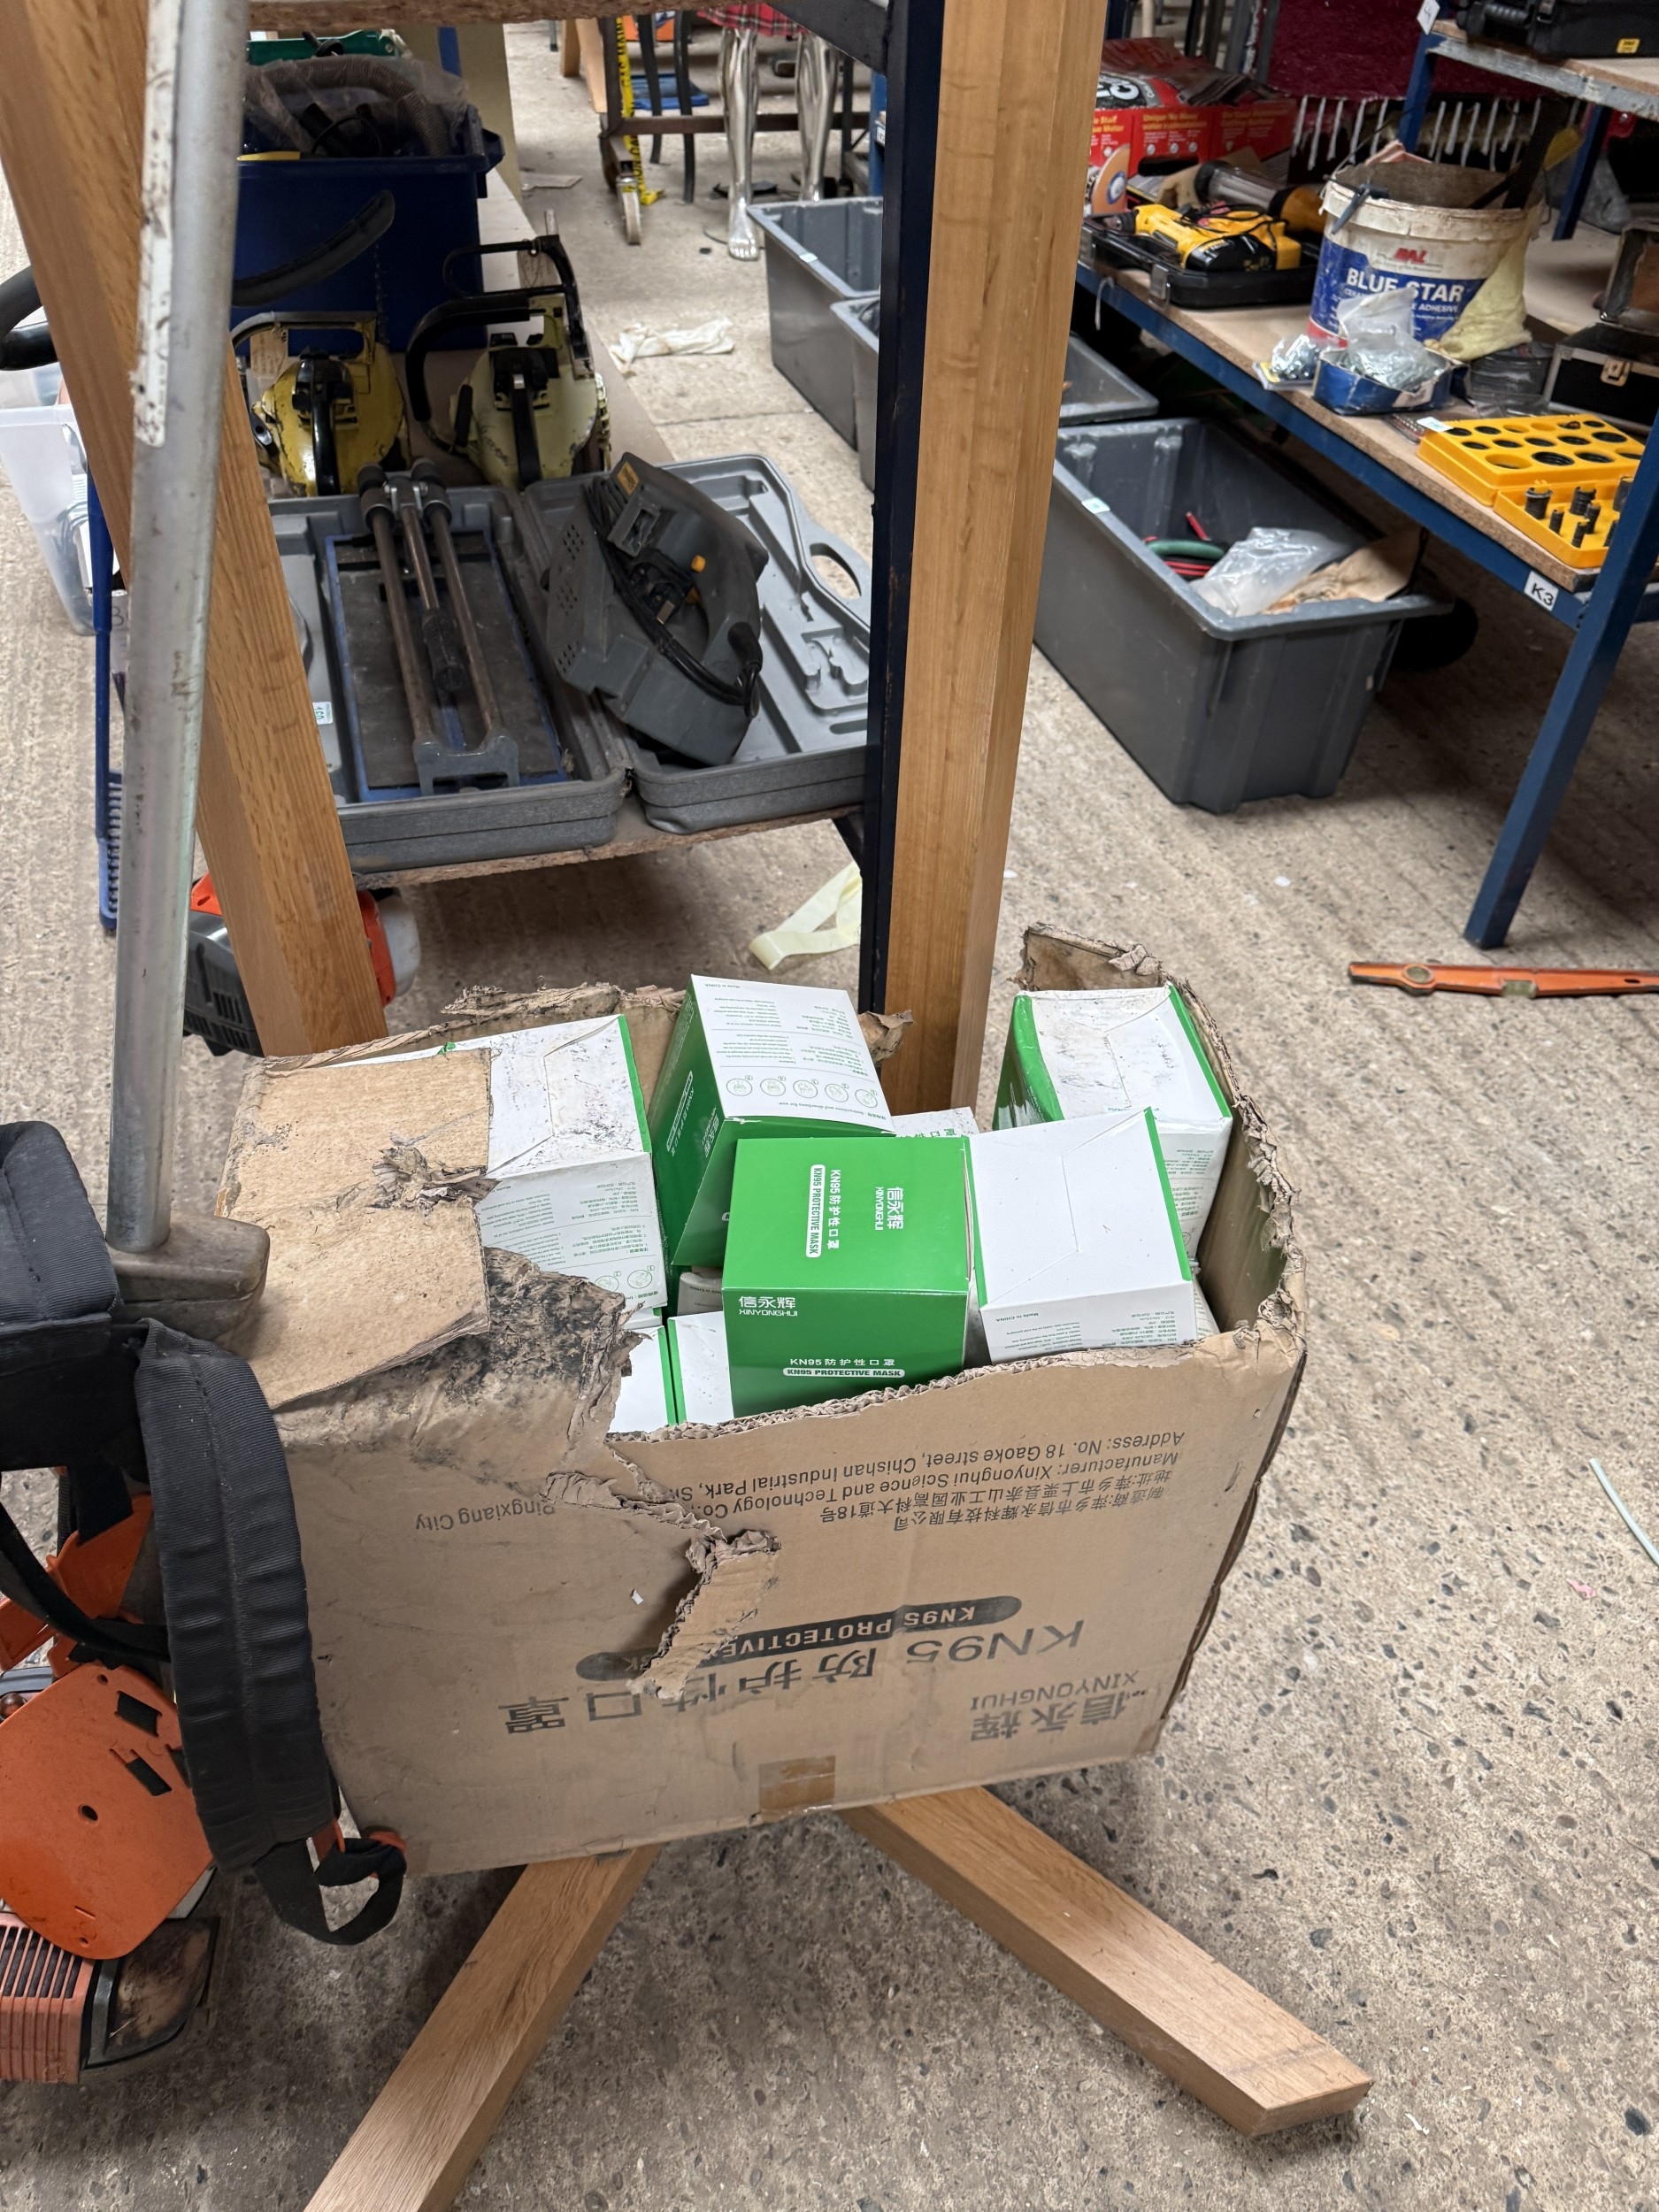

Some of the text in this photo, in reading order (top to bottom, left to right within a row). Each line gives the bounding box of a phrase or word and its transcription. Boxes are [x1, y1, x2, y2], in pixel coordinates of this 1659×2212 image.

[1346, 267, 1465, 303] BLUE STAR
[1532, 583, 1554, 606] K3
[809, 1168, 823, 1254] KN95 PROTECTIVE MASK
[826, 1170, 841, 1249] KN95 防护性口罩
[887, 1187, 904, 1229] 信永辉
[739, 1296, 796, 1309] 信永辉
[983, 1445, 1041, 1466] Gaoke
[1045, 1443, 1065, 1460] 18
[1073, 1440, 1102, 1458] No.
[1107, 1432, 1186, 1455] Address:
[843, 1456, 918, 1483] Chishan
[922, 1449, 979, 1470] street,
[690, 1451, 1179, 1520] Manufacturer: Xinyonghui Science and Technology Co.,
[698, 1480, 747, 1502] Park,
[752, 1468, 838, 1495] Industrial
[415, 1514, 455, 1533] City
[903, 1605, 975, 1628] KN95
[725, 1617, 892, 1657] PROTECTIVE
[905, 1619, 1086, 1665] KN95
[971, 1670, 1139, 1710] XINYONGHUI
[969, 1694, 1127, 1741] 信永辉
